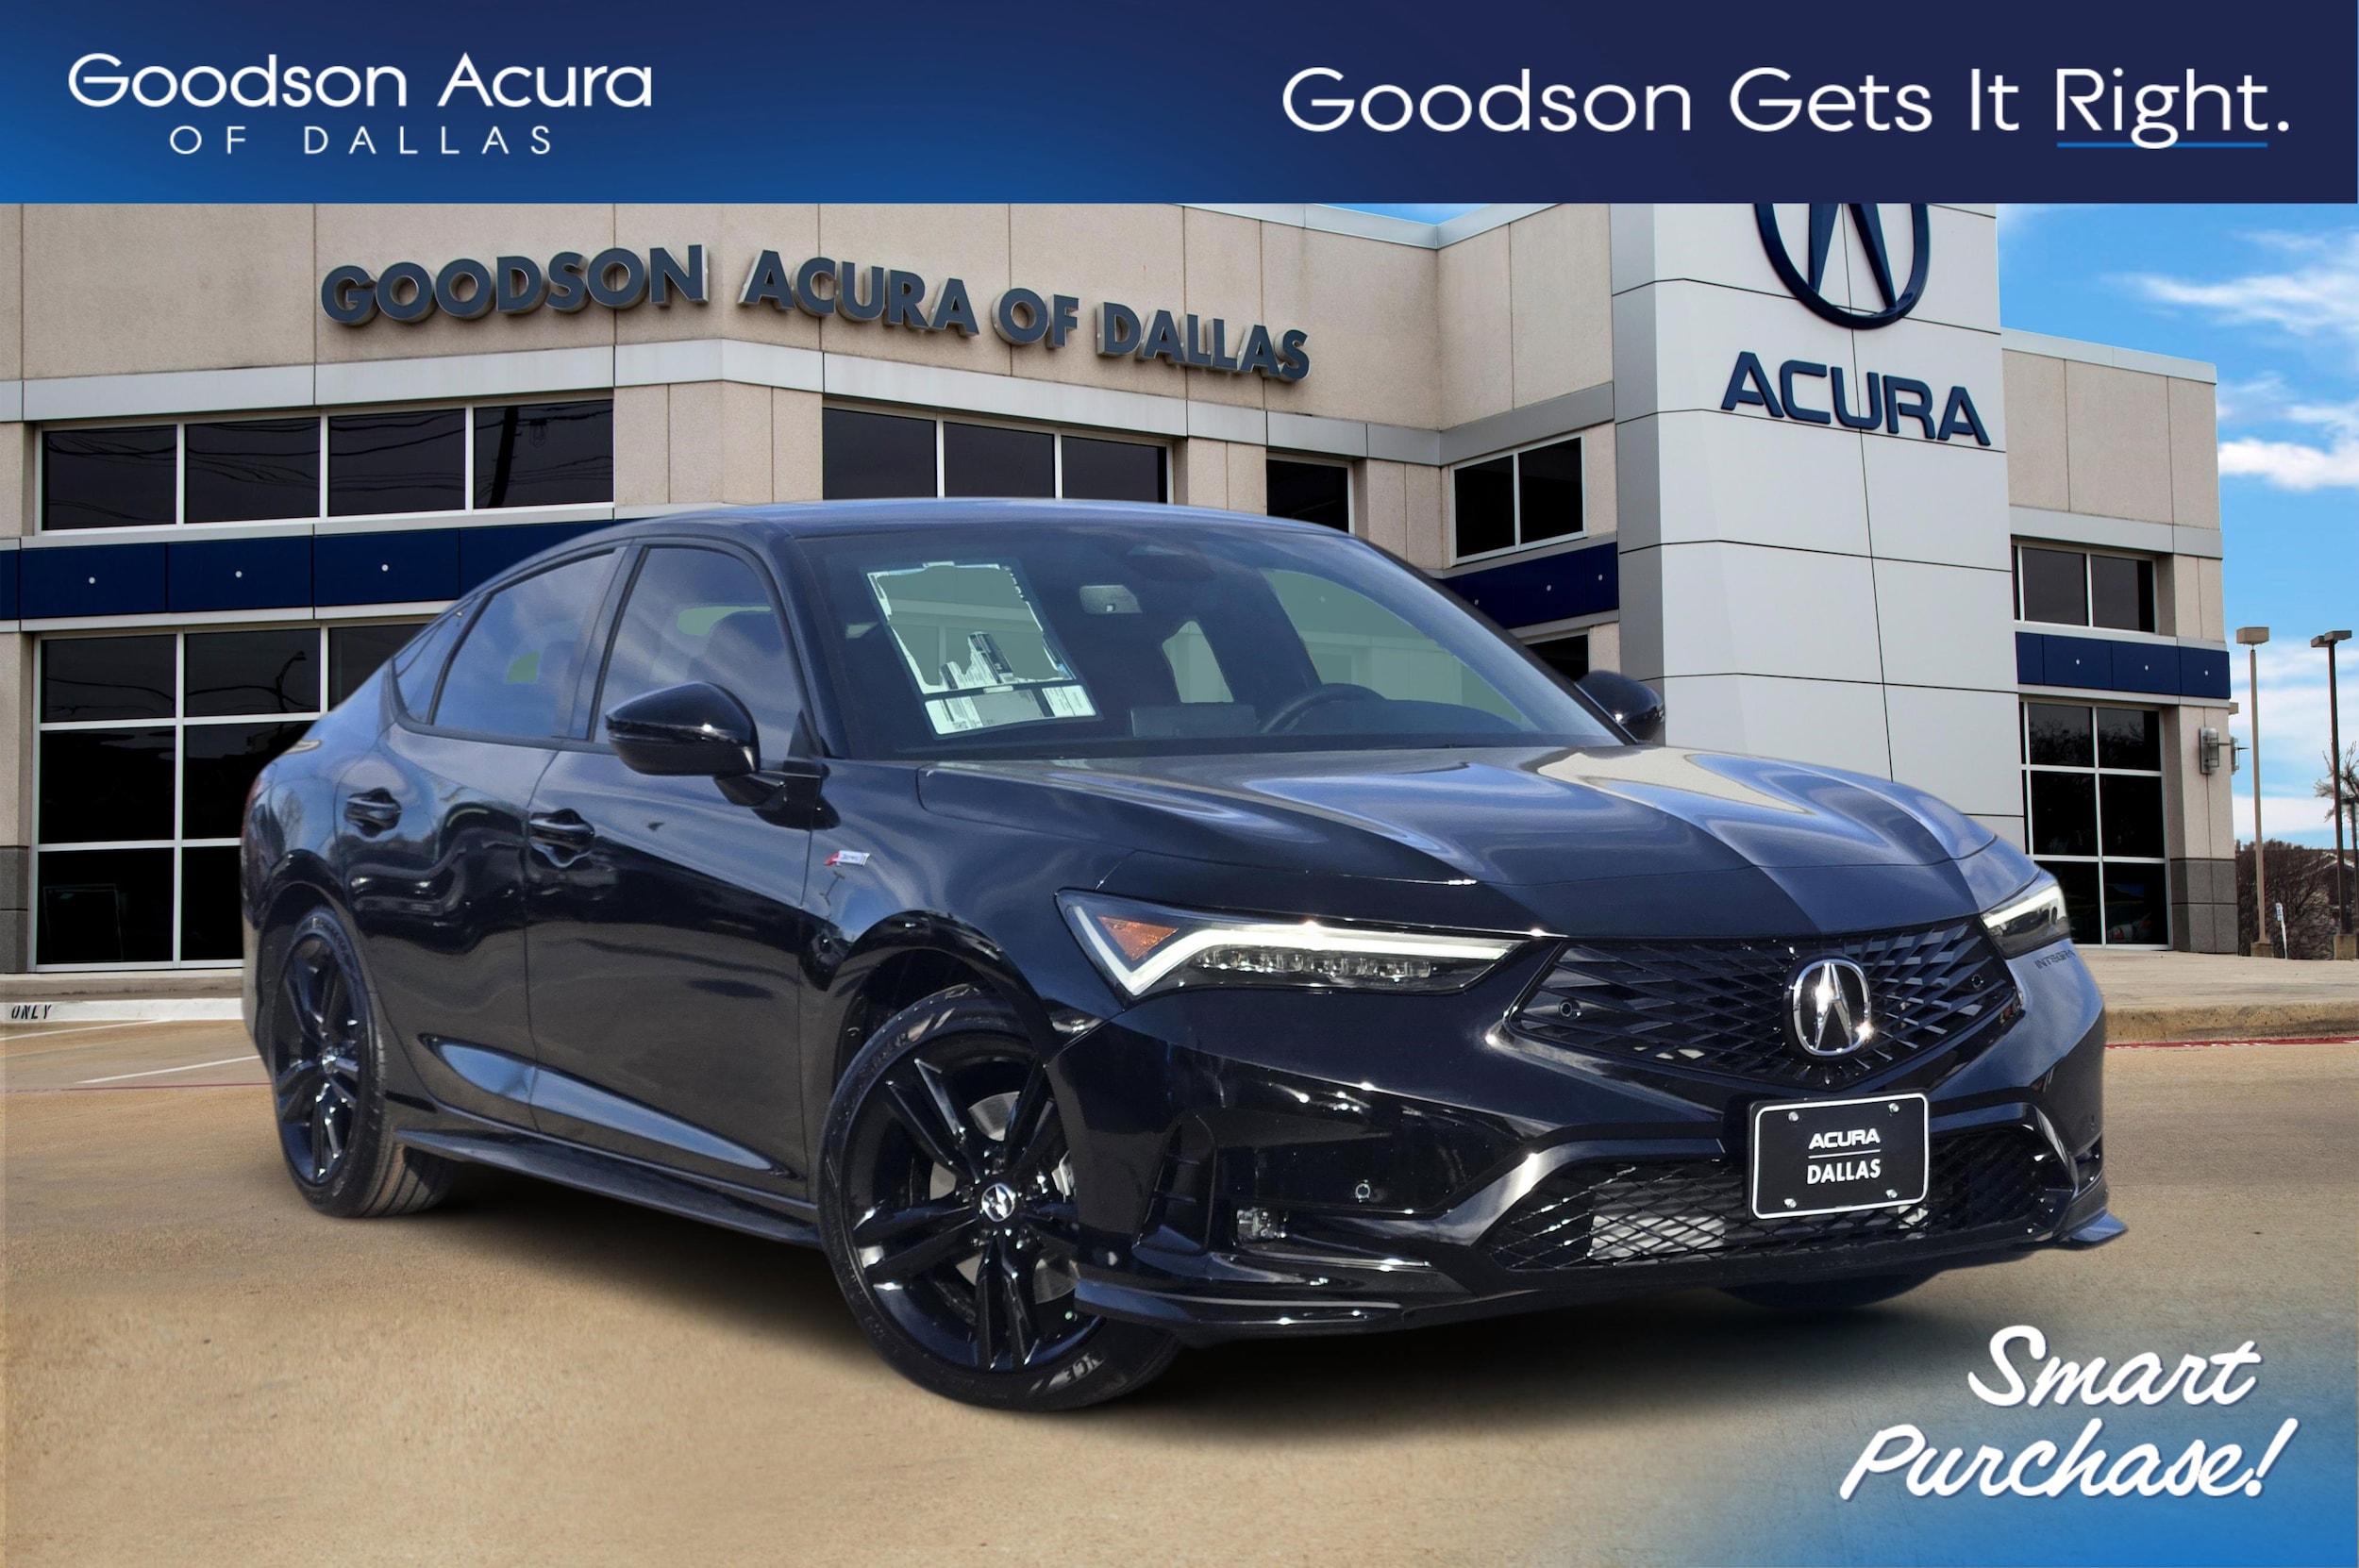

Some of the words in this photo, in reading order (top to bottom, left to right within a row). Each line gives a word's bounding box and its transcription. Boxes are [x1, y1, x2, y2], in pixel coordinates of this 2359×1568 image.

[321, 244, 709, 327] GOODSON
[739, 250, 979, 337] ACURA
[992, 287, 1079, 349] OF
[1096, 301, 1311, 382] DALLAS
[1720, 350, 1991, 446] ACURA
[11, 1004, 52, 1020] ONLY
[1808, 1127, 1881, 1150] ACURA
[1807, 1159, 1882, 1185] DALLAS
